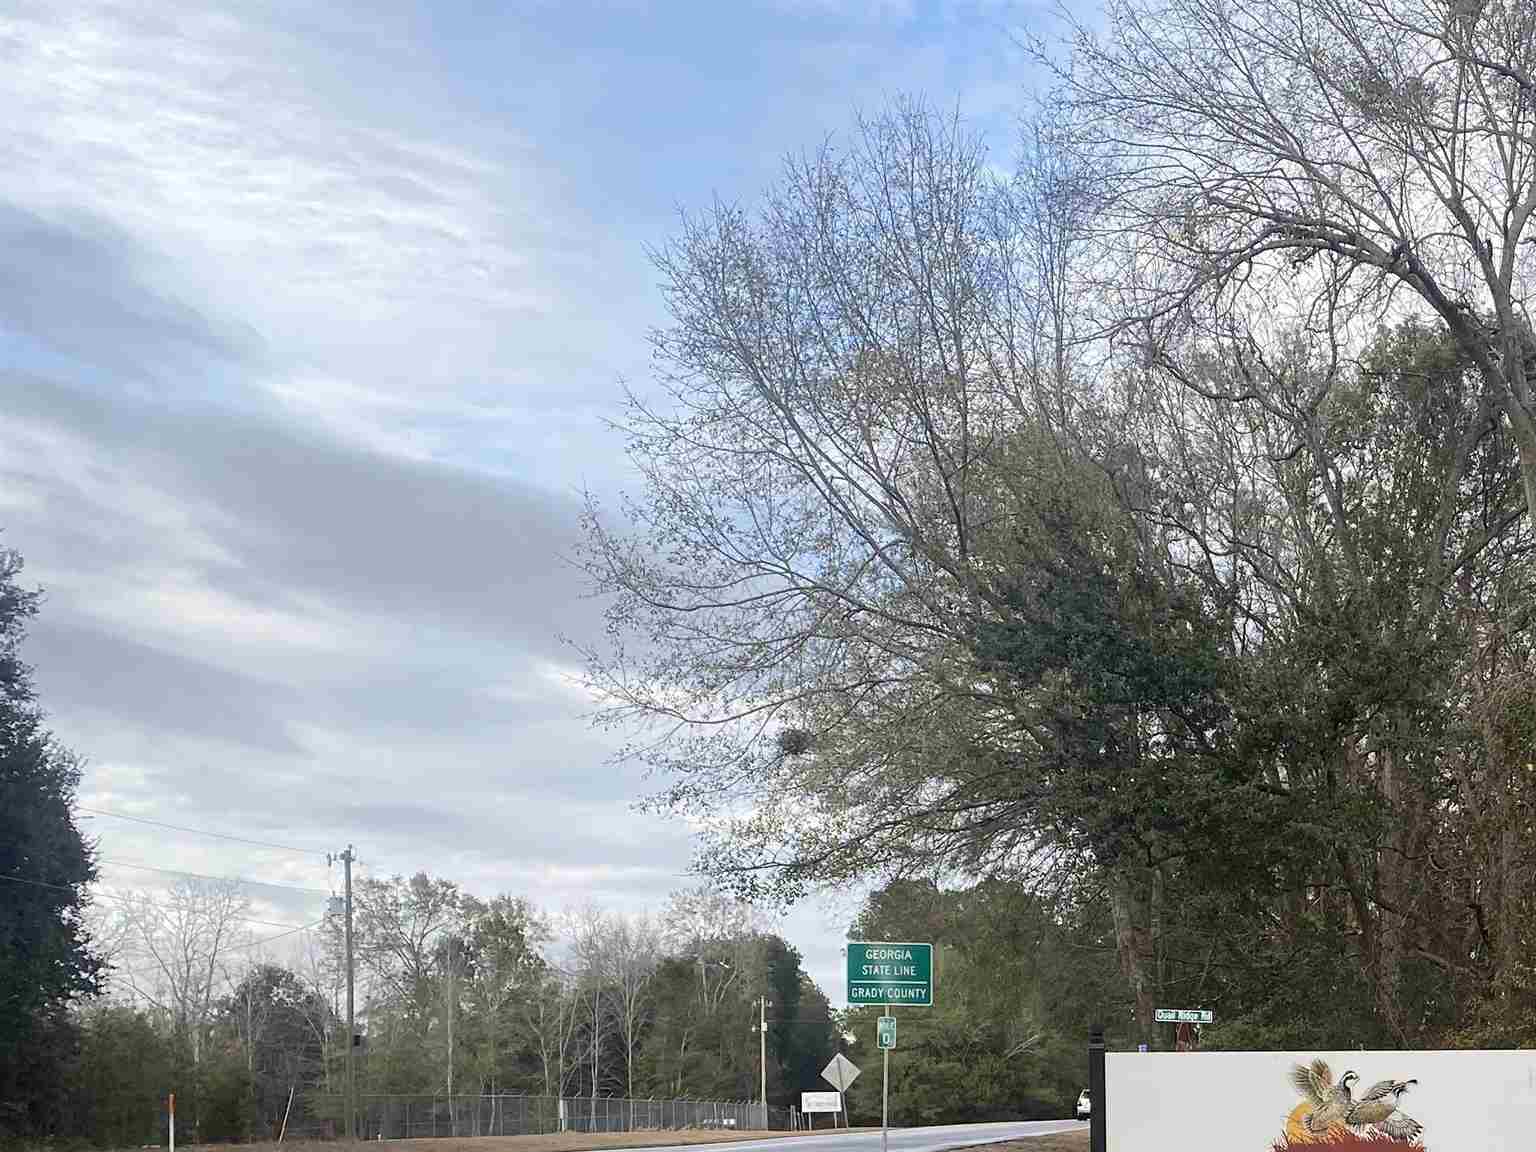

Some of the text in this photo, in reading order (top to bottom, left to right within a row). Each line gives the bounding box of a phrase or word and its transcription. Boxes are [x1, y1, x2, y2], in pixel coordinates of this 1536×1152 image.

[865, 949, 912, 960] GEORGIA
[862, 965, 917, 976] STATE LINE
[851, 987, 927, 999] GRADY COUNTY
